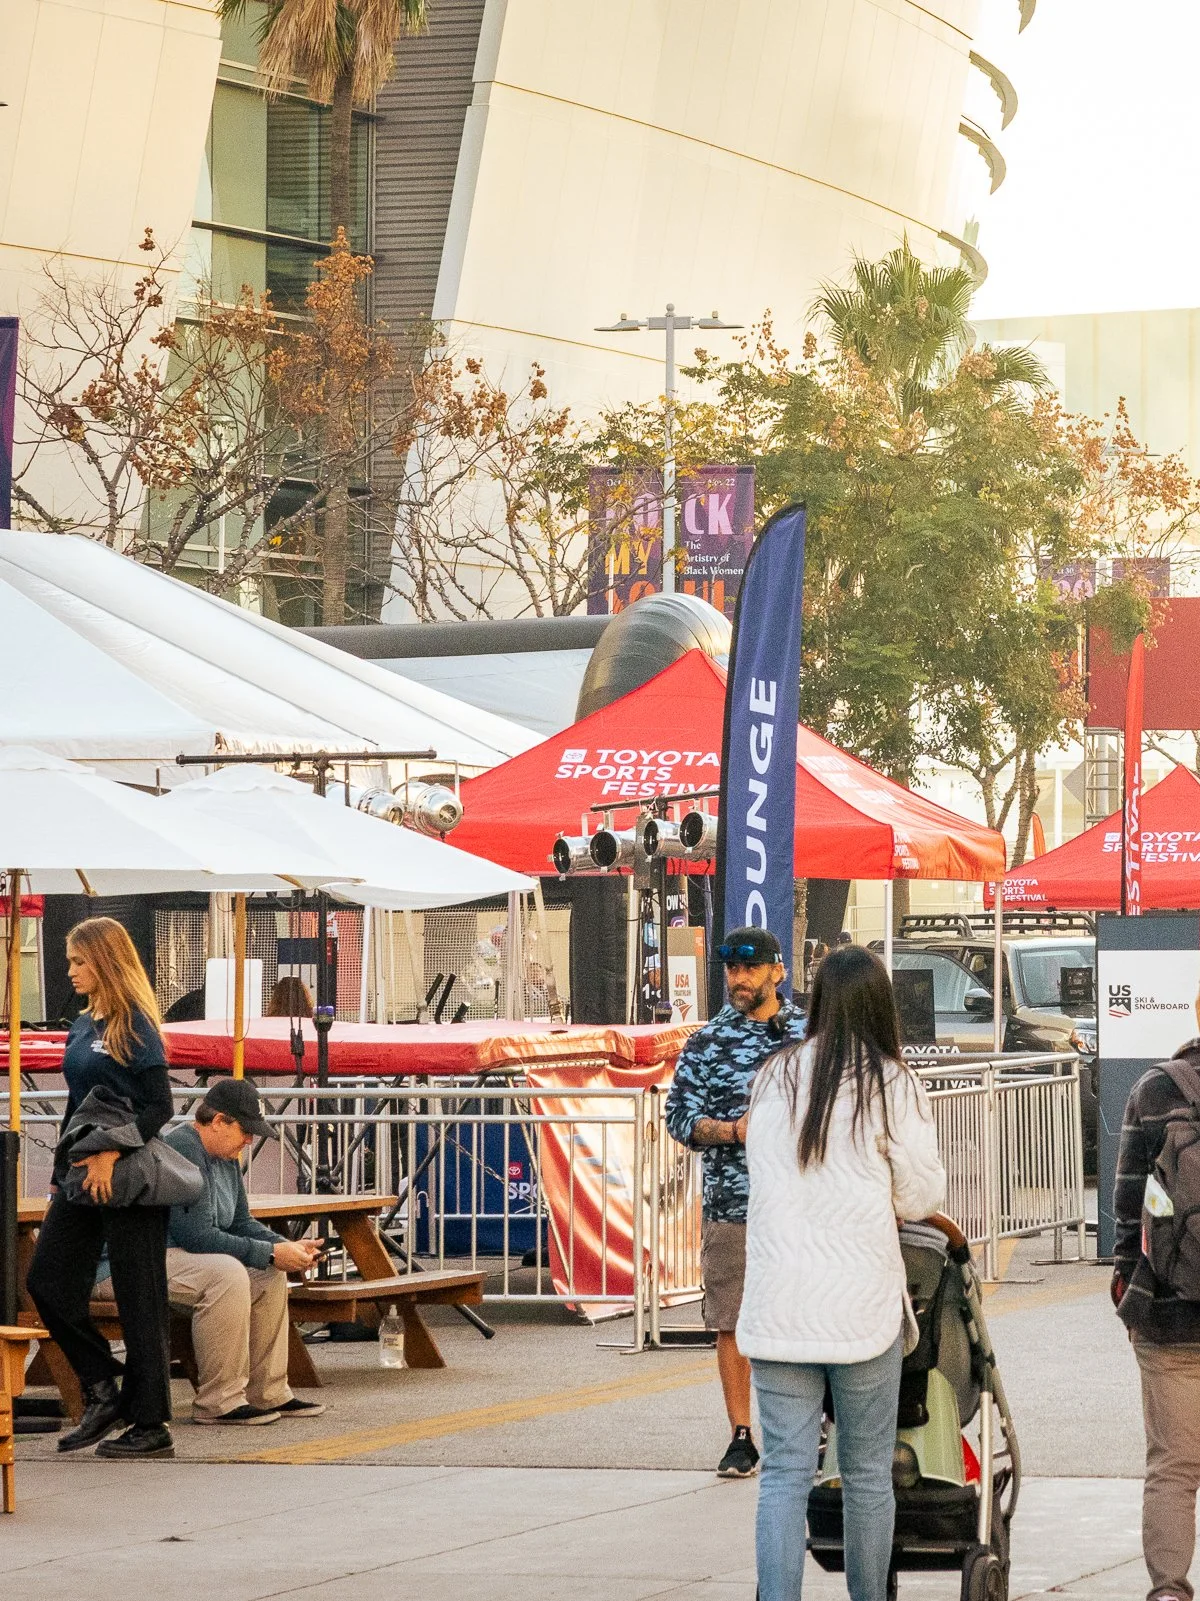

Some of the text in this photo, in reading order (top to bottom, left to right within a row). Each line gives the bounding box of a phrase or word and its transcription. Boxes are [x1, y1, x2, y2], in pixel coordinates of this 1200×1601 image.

[684, 539, 702, 550] The
[604, 538, 656, 575] MY
[684, 553, 731, 564] Artistry of
[683, 565, 744, 576] Black Women
[596, 749, 721, 767] TOYOTA
[555, 764, 673, 781] SPORTS
[601, 781, 721, 797] FESTIV
[745, 677, 777, 932] OUNGE
[1102, 842, 1178, 853] SPRTS
[1004, 879, 1039, 887] OYOTA
[989, 887, 1025, 895] SORTS
[1004, 894, 1049, 902] FESTIVAL
[675, 974, 690, 988] USA
[1109, 985, 1131, 997] US
